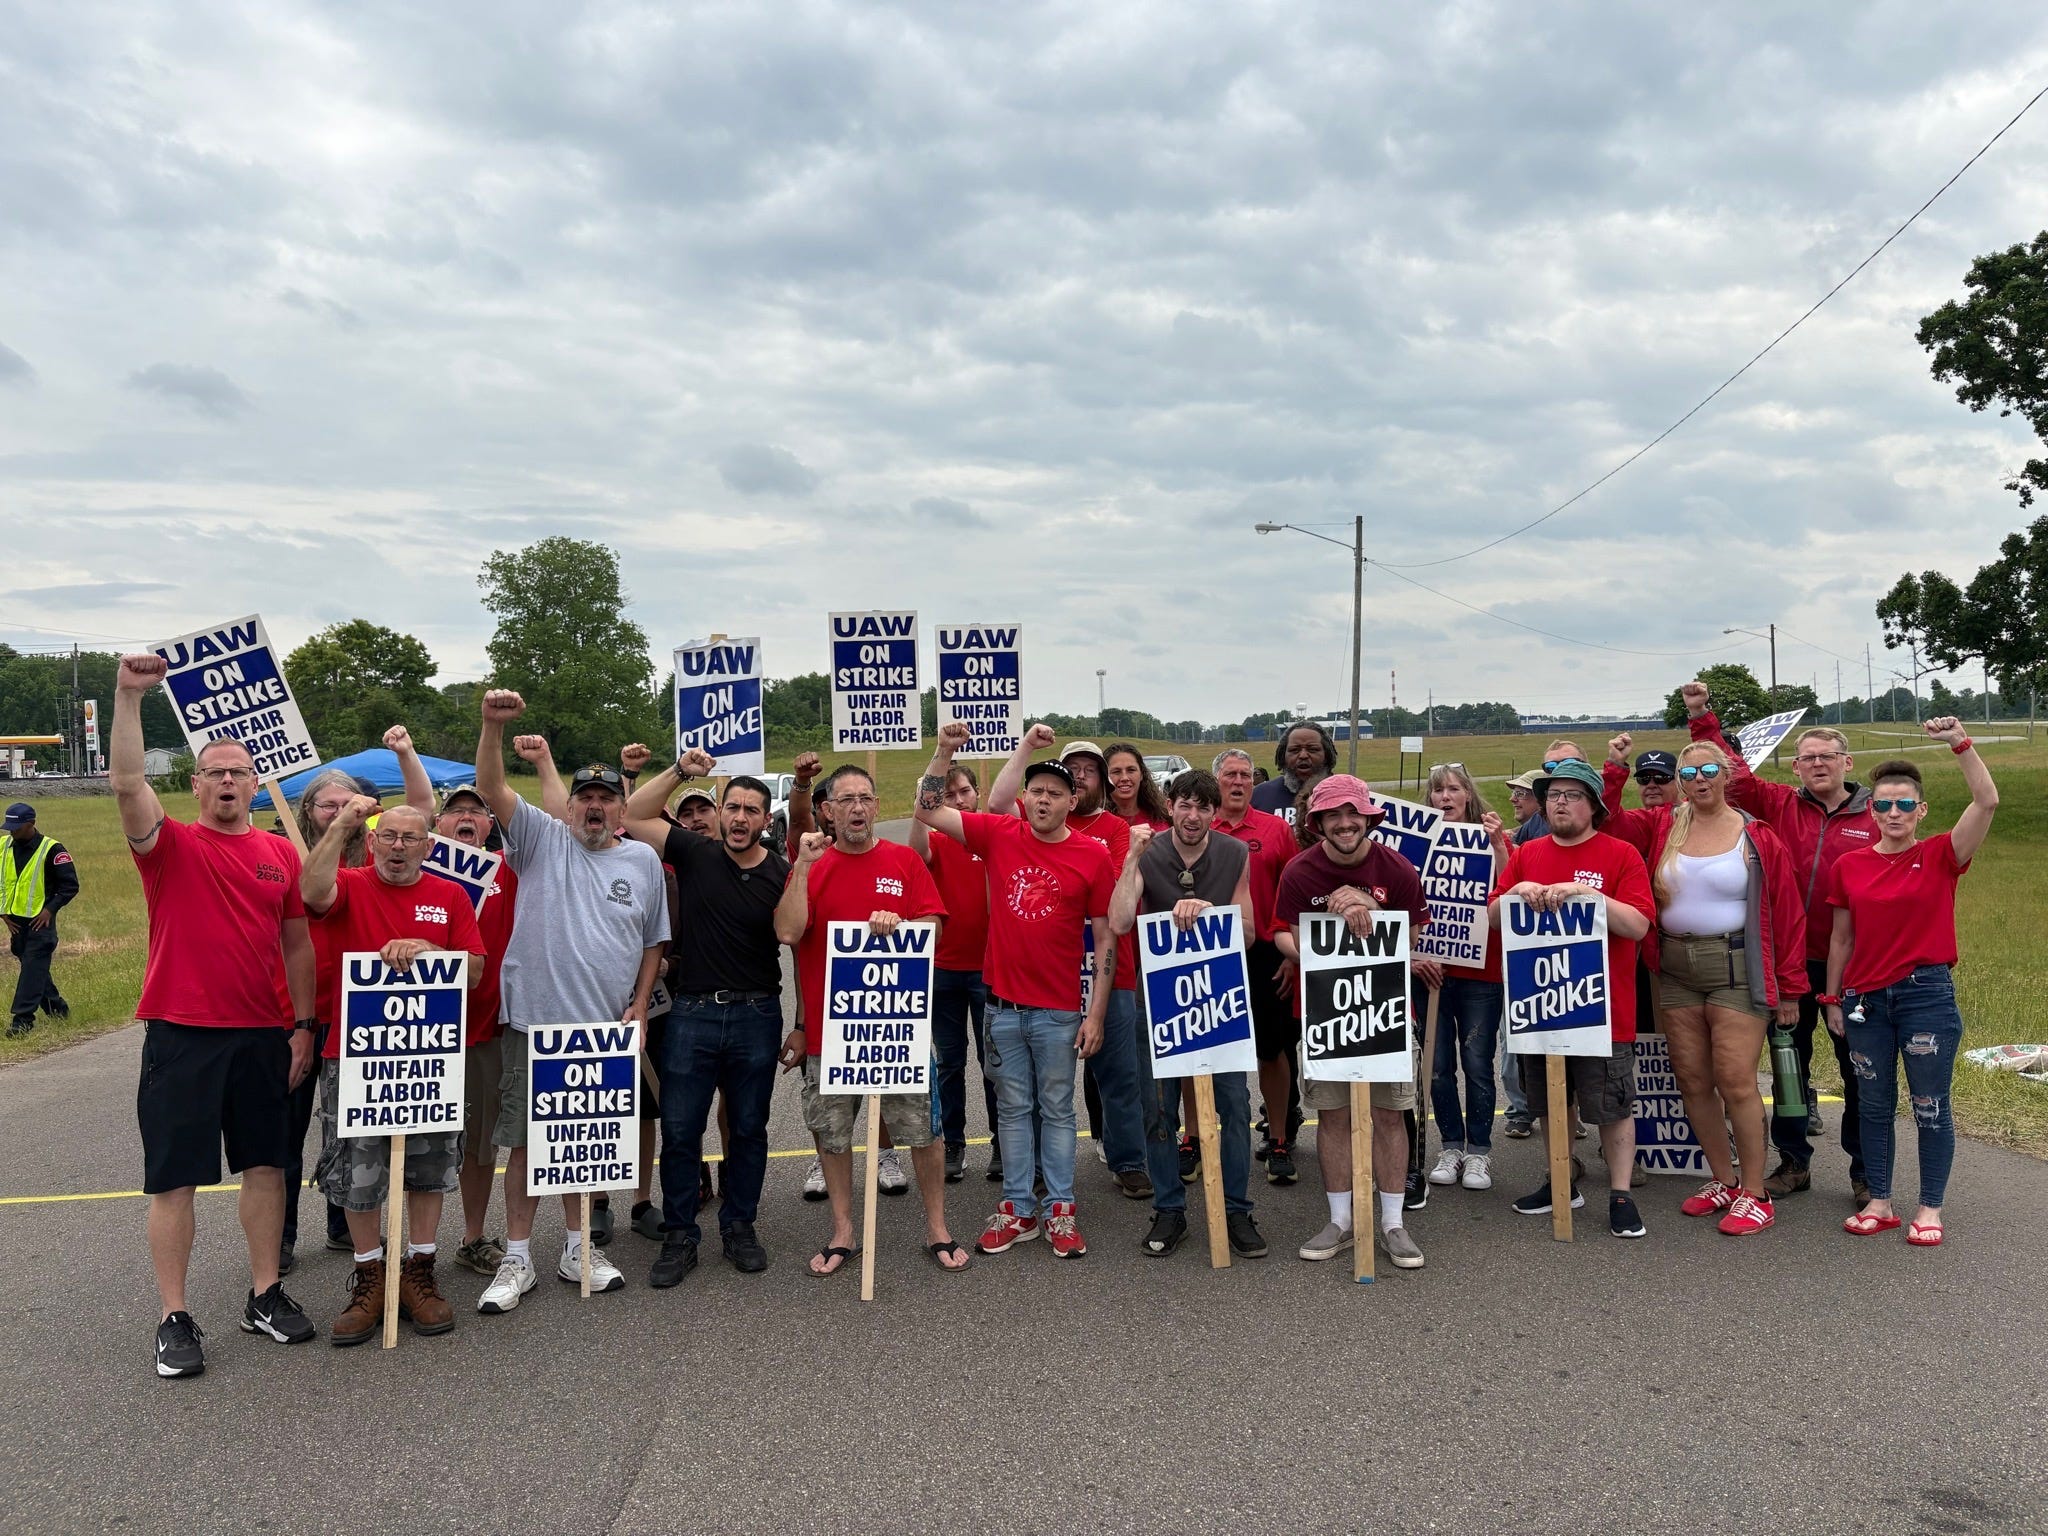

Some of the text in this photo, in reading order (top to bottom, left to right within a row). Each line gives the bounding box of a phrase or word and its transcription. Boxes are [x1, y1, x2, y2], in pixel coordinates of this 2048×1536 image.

[834, 616, 914, 637] UAW
[156, 620, 257, 669] UAW
[940, 628, 1017, 650] UAW
[683, 645, 754, 676] UAW
[859, 644, 890, 664] ON
[203, 661, 245, 691] ON
[838, 666, 914, 687] STRIKE
[964, 656, 993, 676] ON
[943, 677, 1017, 698] STRIKE
[185, 678, 284, 725] STRIKE
[702, 685, 733, 719] ON
[848, 693, 906, 709] UNFAIR
[952, 704, 1009, 719] UNFAIR
[681, 706, 760, 752] STRIKE
[851, 710, 904, 726] LABOR
[967, 720, 1007, 736] ABOR
[247, 729, 289, 756] BOR
[839, 727, 917, 744] PRACTICE
[955, 737, 1019, 752] ACTICE
[1742, 735, 1779, 748] RIKE
[1745, 727, 1771, 740] ON
[255, 742, 312, 775] CTICE
[1370, 798, 1438, 834] AW
[1436, 827, 1490, 851] AW
[256, 862, 285, 874] LOCAL
[424, 841, 495, 881] AW
[1435, 854, 1465, 876] ON
[876, 876, 903, 889] LOCAL
[1011, 867, 1059, 891] GRAFFITI
[1574, 870, 1604, 881] LOCAL
[875, 884, 904, 897] 2093
[1424, 876, 1487, 901] TRIKE
[415, 904, 448, 915] LOCAL
[1007, 893, 1037, 919] SUPPLY
[1428, 903, 1475, 923] NFAIR
[414, 912, 448, 925] 2093
[1509, 902, 1596, 936] UAW
[834, 928, 931, 953] UAW
[1146, 913, 1233, 956] UAW
[1310, 920, 1401, 957] UAW
[1416, 938, 1481, 960] RACTICE
[350, 958, 463, 986] UAW
[862, 962, 899, 987] ON
[1534, 948, 1570, 988] ON
[1175, 964, 1212, 1007] ON
[1333, 969, 1372, 1011] ON
[383, 994, 426, 1021] ON
[832, 990, 925, 1014] STRIKE
[1510, 973, 1605, 1031] STRIKE
[1153, 986, 1247, 1054] STRIKE
[1306, 996, 1406, 1057] STRIKE
[350, 1022, 458, 1051] STRIKE
[533, 1026, 635, 1055] UAW
[842, 1023, 914, 1042] UNFAIR
[845, 1044, 909, 1063] LABOR
[362, 1059, 445, 1081] UNFAIR
[564, 1062, 603, 1087] ON
[828, 1066, 924, 1085] PRACTICE
[1639, 1058, 1674, 1074] BOR
[365, 1082, 440, 1104] LABOR
[1637, 1076, 1676, 1092] FAIR
[535, 1088, 632, 1115] STRIKE
[1632, 1099, 1685, 1119] RIKE
[347, 1102, 458, 1127] PRACTICE
[546, 1121, 621, 1143] UNFAIR
[1656, 1121, 1689, 1141] ON
[549, 1142, 617, 1164] LABOR
[533, 1162, 633, 1186] PRACTICE
